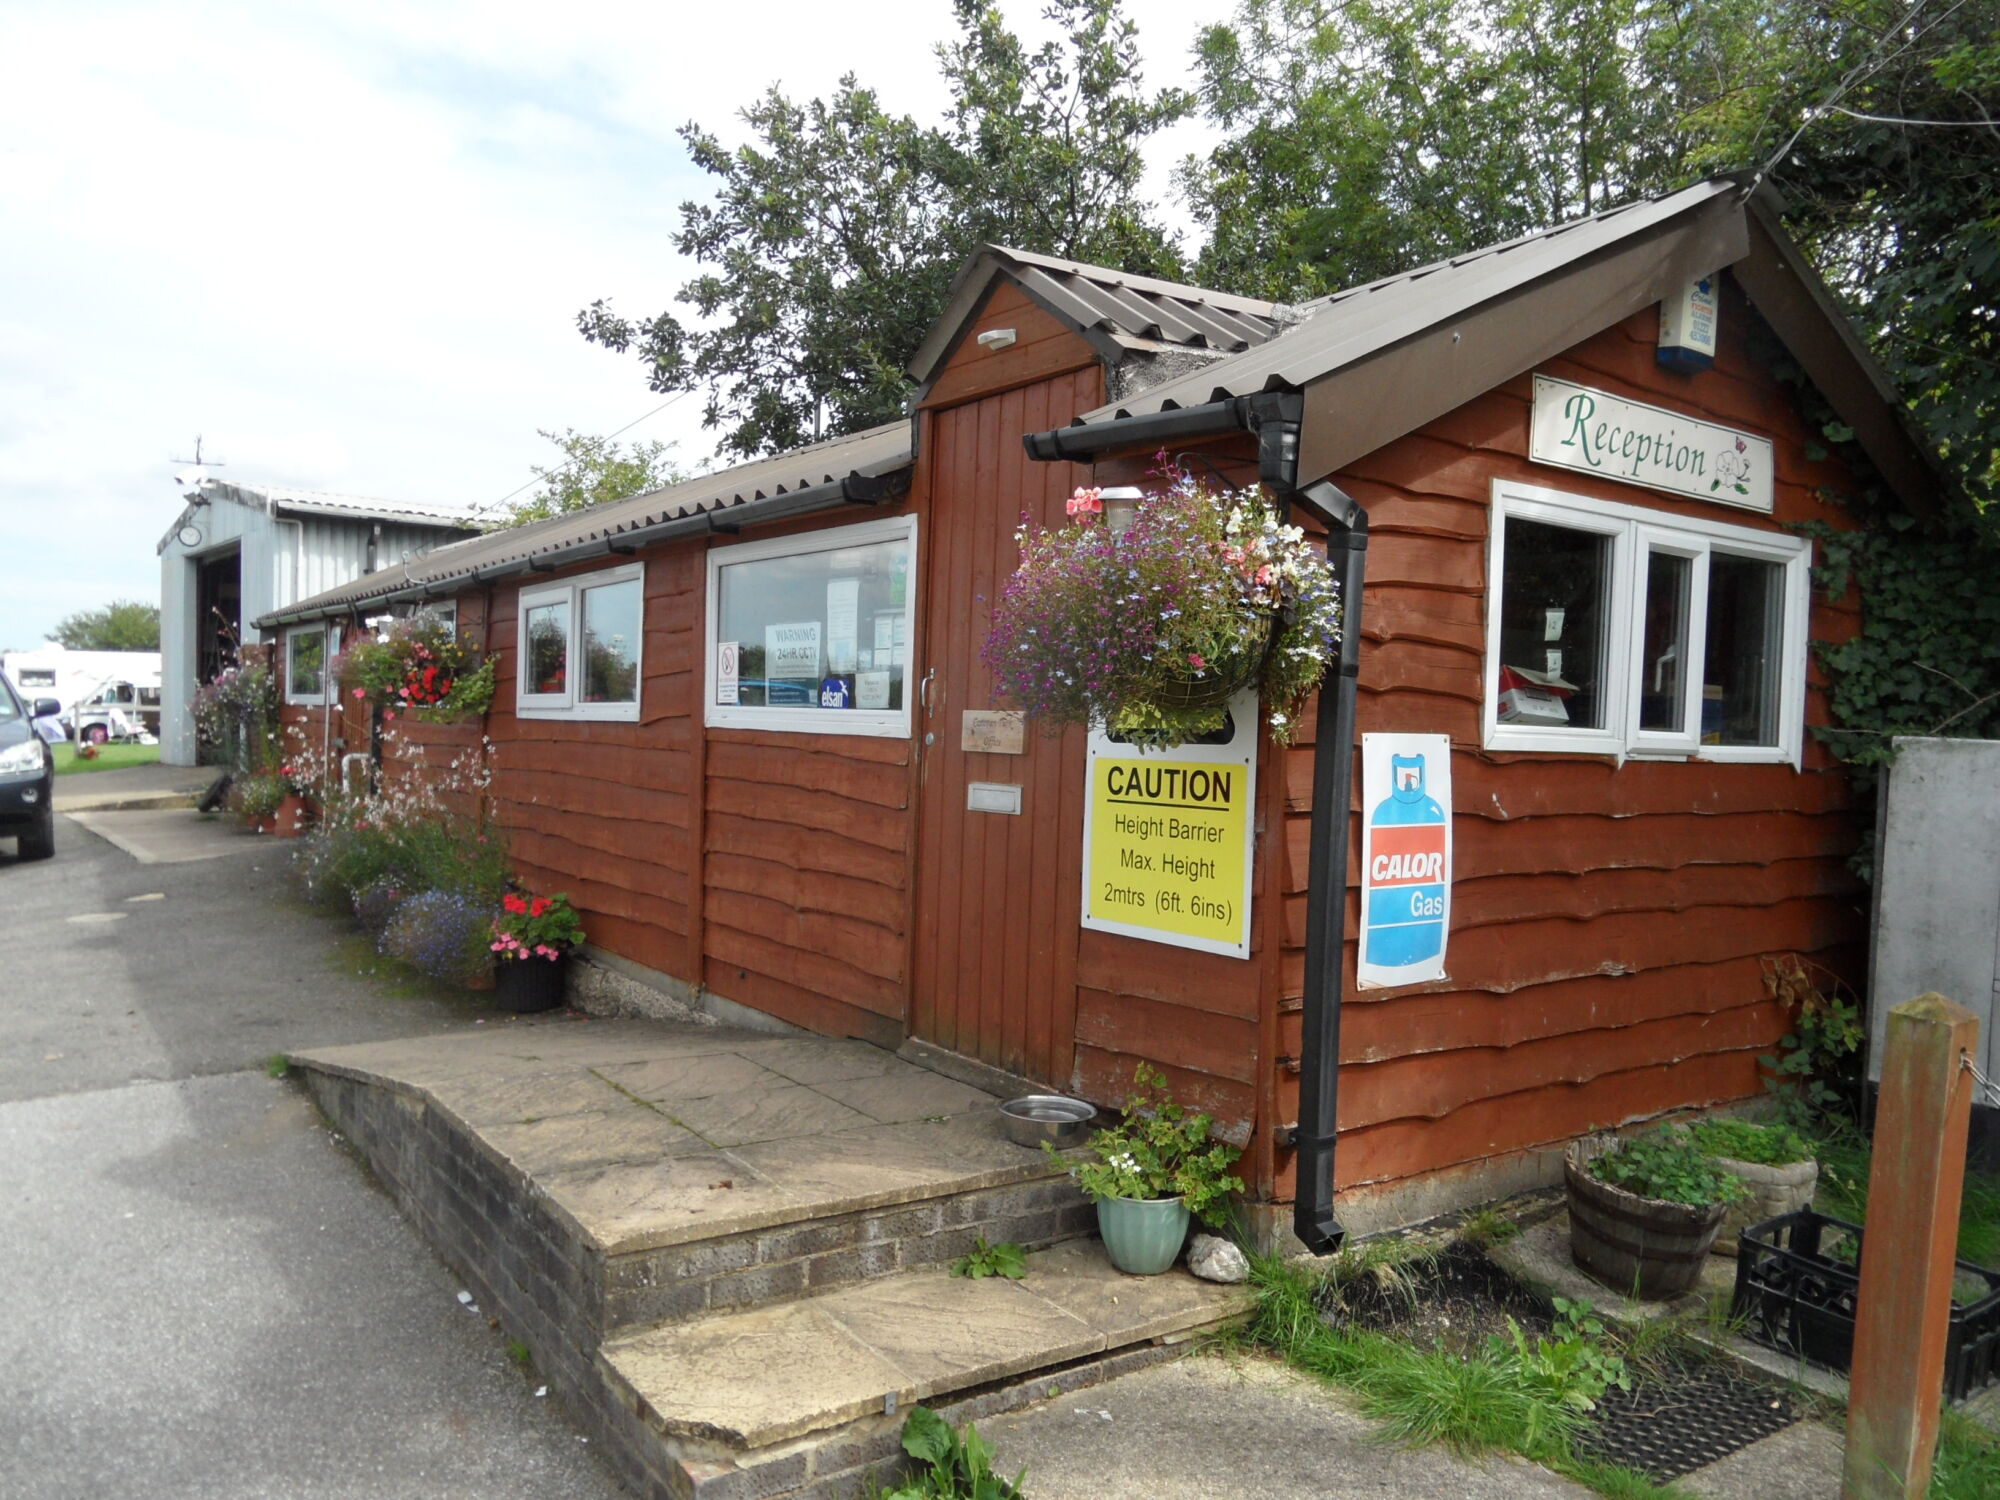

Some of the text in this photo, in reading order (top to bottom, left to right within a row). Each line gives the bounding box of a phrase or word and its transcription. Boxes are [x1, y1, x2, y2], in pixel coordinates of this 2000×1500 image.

[1561, 393, 1707, 477] Reception
[775, 627, 816, 643] WARNING
[777, 647, 817, 660] 24HR CCTV
[822, 686, 843, 707] elsan
[1107, 766, 1231, 803] CAUTION
[1115, 814, 1224, 843] Height Barrier
[1120, 848, 1215, 881] Max. Height
[1372, 852, 1443, 883] CALOR
[1104, 882, 1232, 926] 2mtrs (6ft. 6ins)
[1411, 891, 1443, 917] Gas
